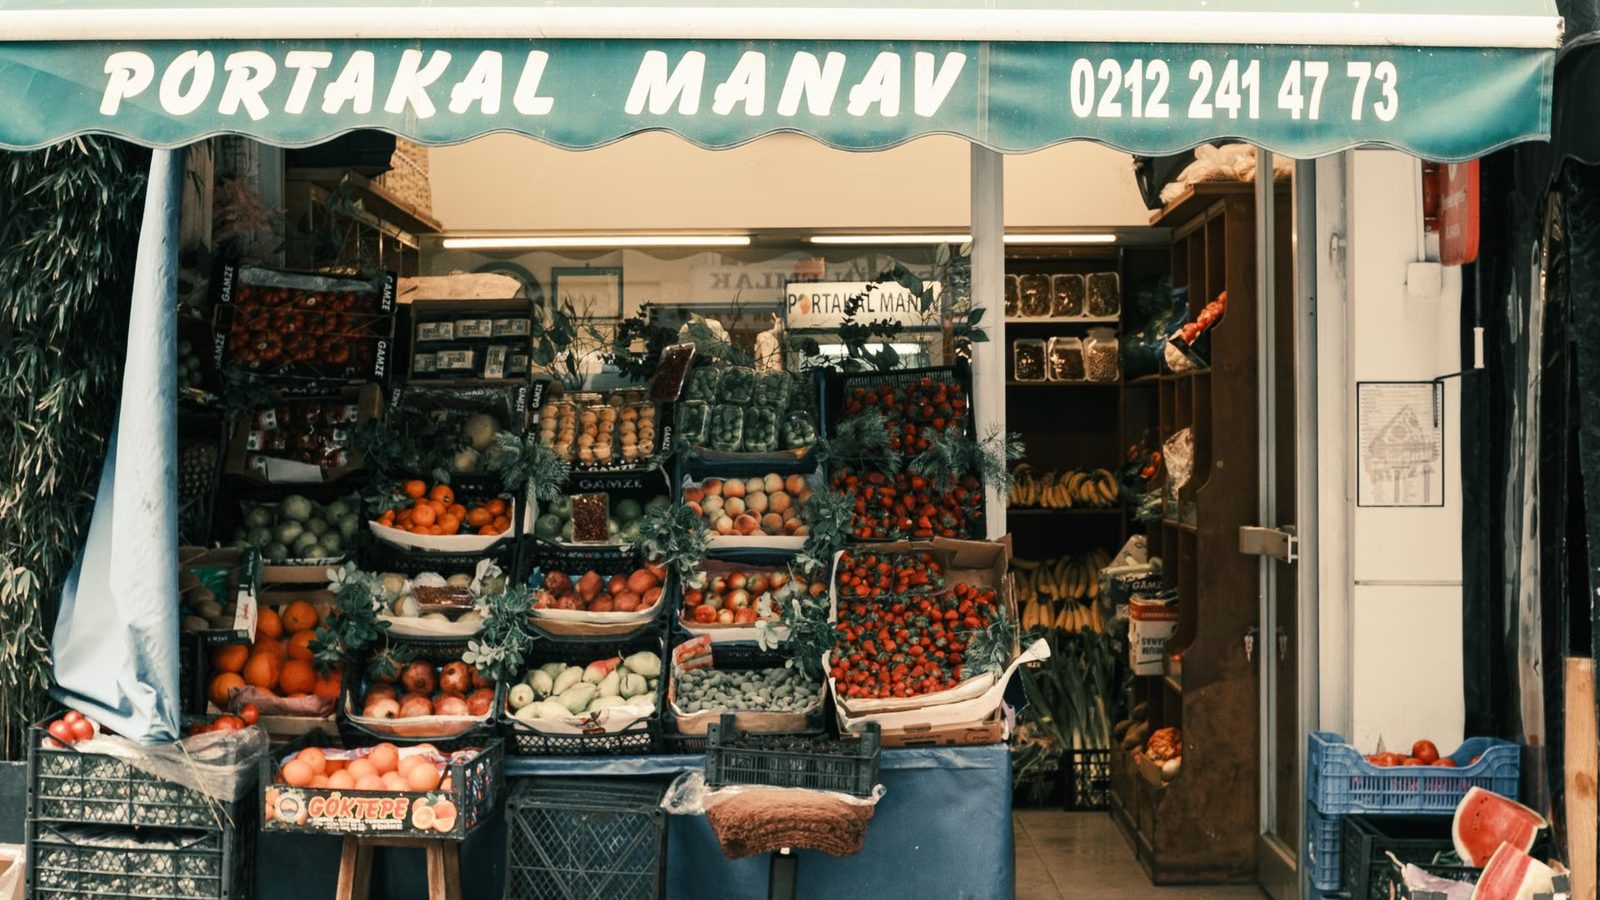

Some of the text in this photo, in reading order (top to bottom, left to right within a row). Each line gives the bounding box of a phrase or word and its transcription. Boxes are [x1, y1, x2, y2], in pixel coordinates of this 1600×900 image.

[99, 50, 967, 121] PORTAKAL MANAV
[1070, 57, 1399, 122] 0212 241 47 73
[221, 264, 234, 302] GAMZE
[374, 340, 387, 378] GAMZE
[531, 384, 543, 409] GAMZE
[579, 479, 643, 489] GAMZE
[308, 791, 409, 820] GÖKTEPE
